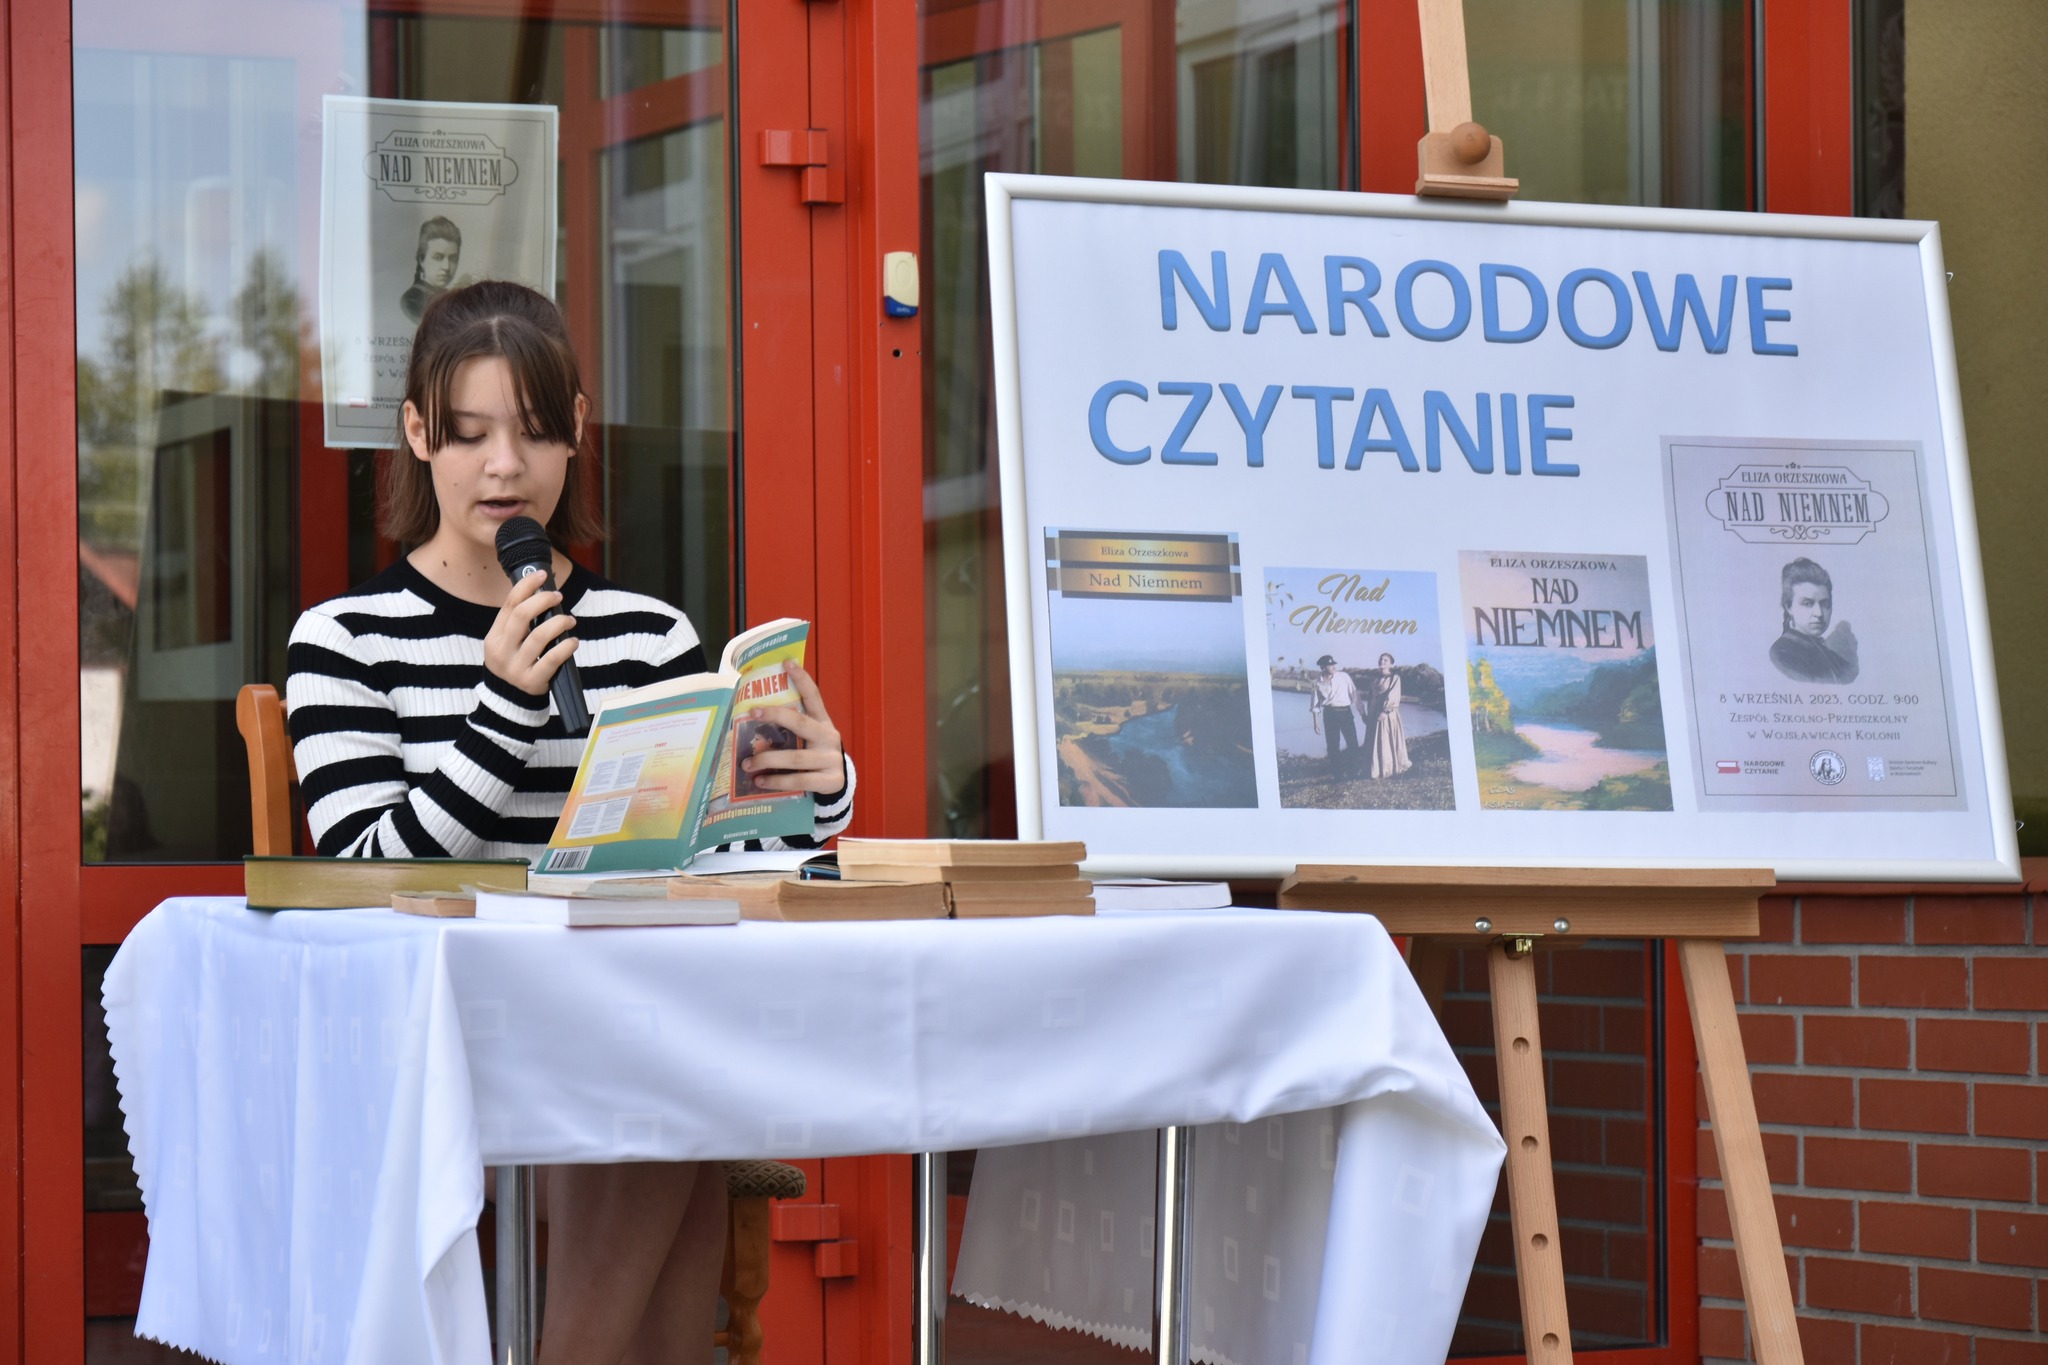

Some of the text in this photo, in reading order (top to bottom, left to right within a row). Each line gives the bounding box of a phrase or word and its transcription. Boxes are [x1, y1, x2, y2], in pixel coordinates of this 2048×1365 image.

[394, 136, 486, 150] ELIZA ORZESZKOWA
[379, 153, 502, 186] NAD NIEMNEM
[1157, 248, 1799, 357] NARODOWE
[1087, 379, 1581, 478] CZYTANIE
[1741, 471, 1848, 485] ELIZA ORZESZKOWA
[1724, 491, 1871, 523] NAD NIEMNEM
[1101, 546, 1189, 558] Eliza Orzeszkowa
[1490, 557, 1617, 571] ELIZA ORZESZKOWA
[1088, 573, 1204, 589] Nad Niemnem
[1317, 573, 1391, 602] Nad
[1530, 577, 1579, 605] NAD
[1288, 605, 1418, 635] Niemnem
[1472, 606, 1646, 650] NIEMNEM
[1719, 694, 1727, 704] 8
[1733, 691, 1804, 705] WRZEŚNIA
[1848, 694, 1889, 705] GODZ.
[1893, 694, 1920, 705] 9:00
[1744, 760, 1785, 768] NARODOWE
